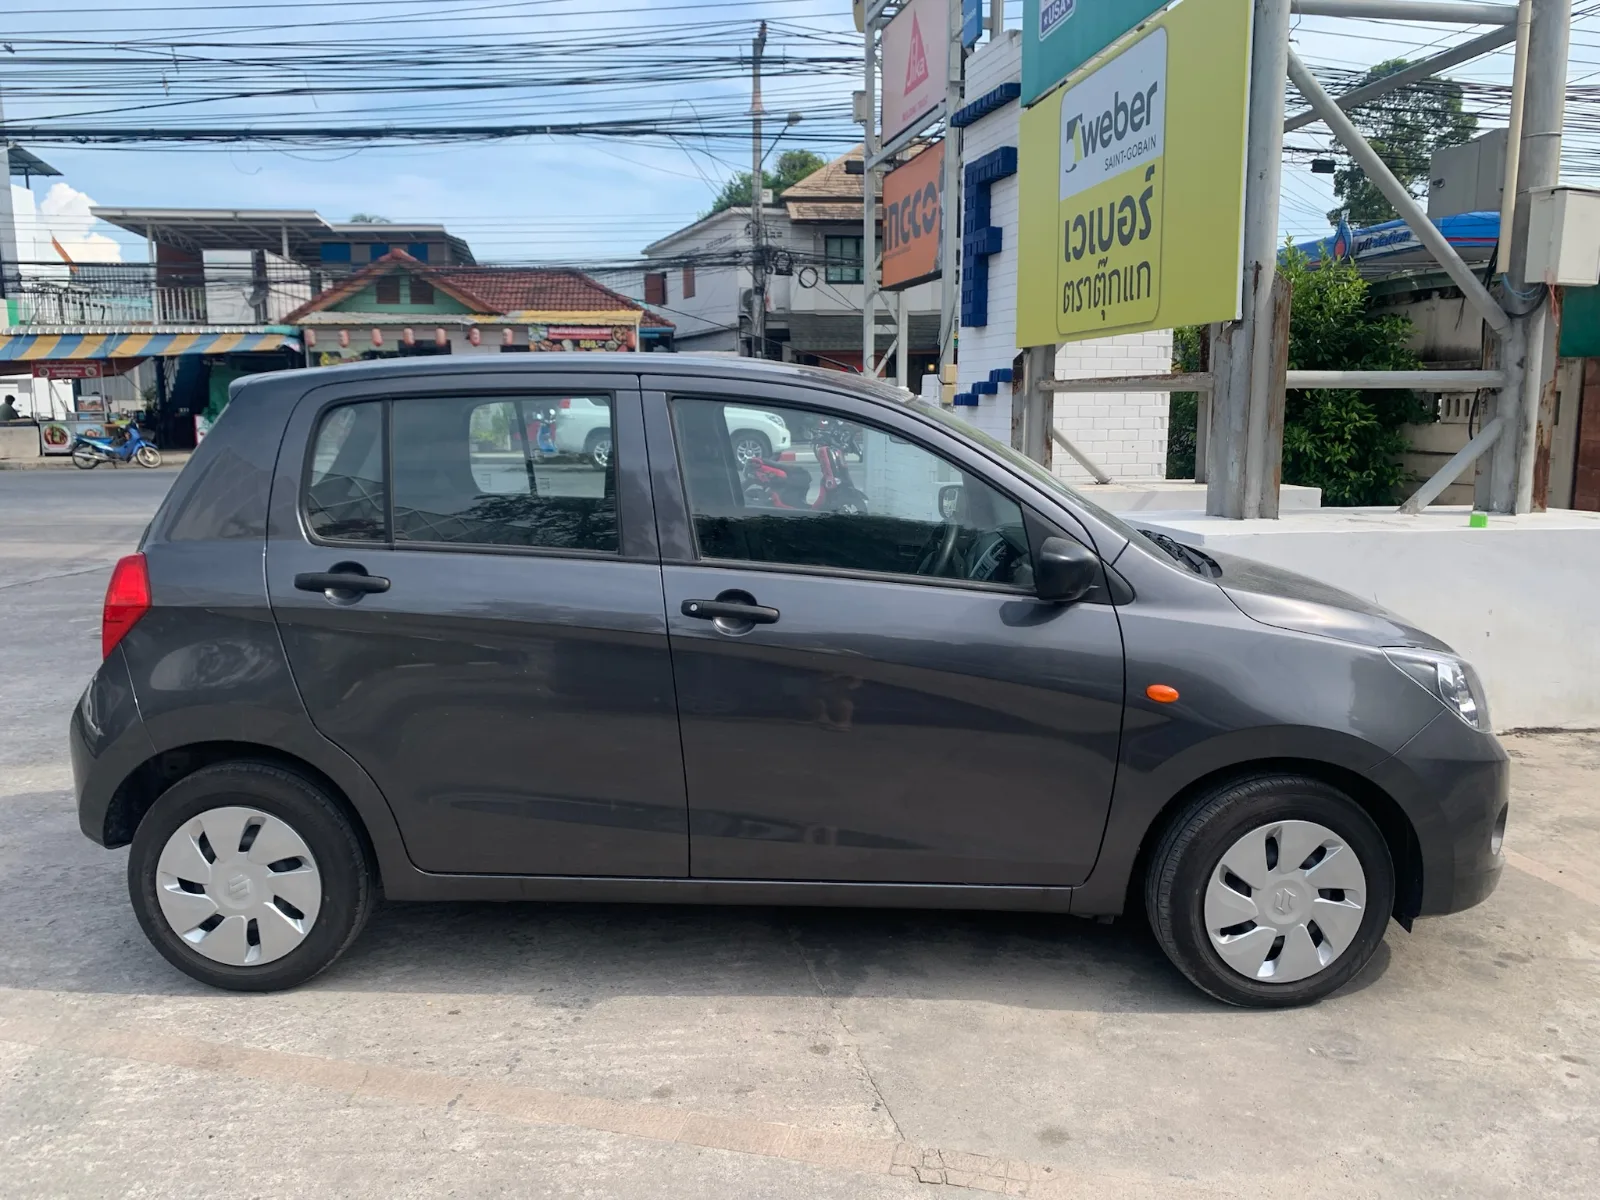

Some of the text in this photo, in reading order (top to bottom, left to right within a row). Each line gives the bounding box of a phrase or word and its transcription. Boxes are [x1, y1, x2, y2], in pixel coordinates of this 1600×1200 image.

[1081, 80, 1158, 158] weber
[1104, 134, 1157, 171] SAINT-GOBAIN
[1064, 164, 1156, 263] เวเบอร์
[1063, 256, 1151, 321] ตราตุ๊กแก
